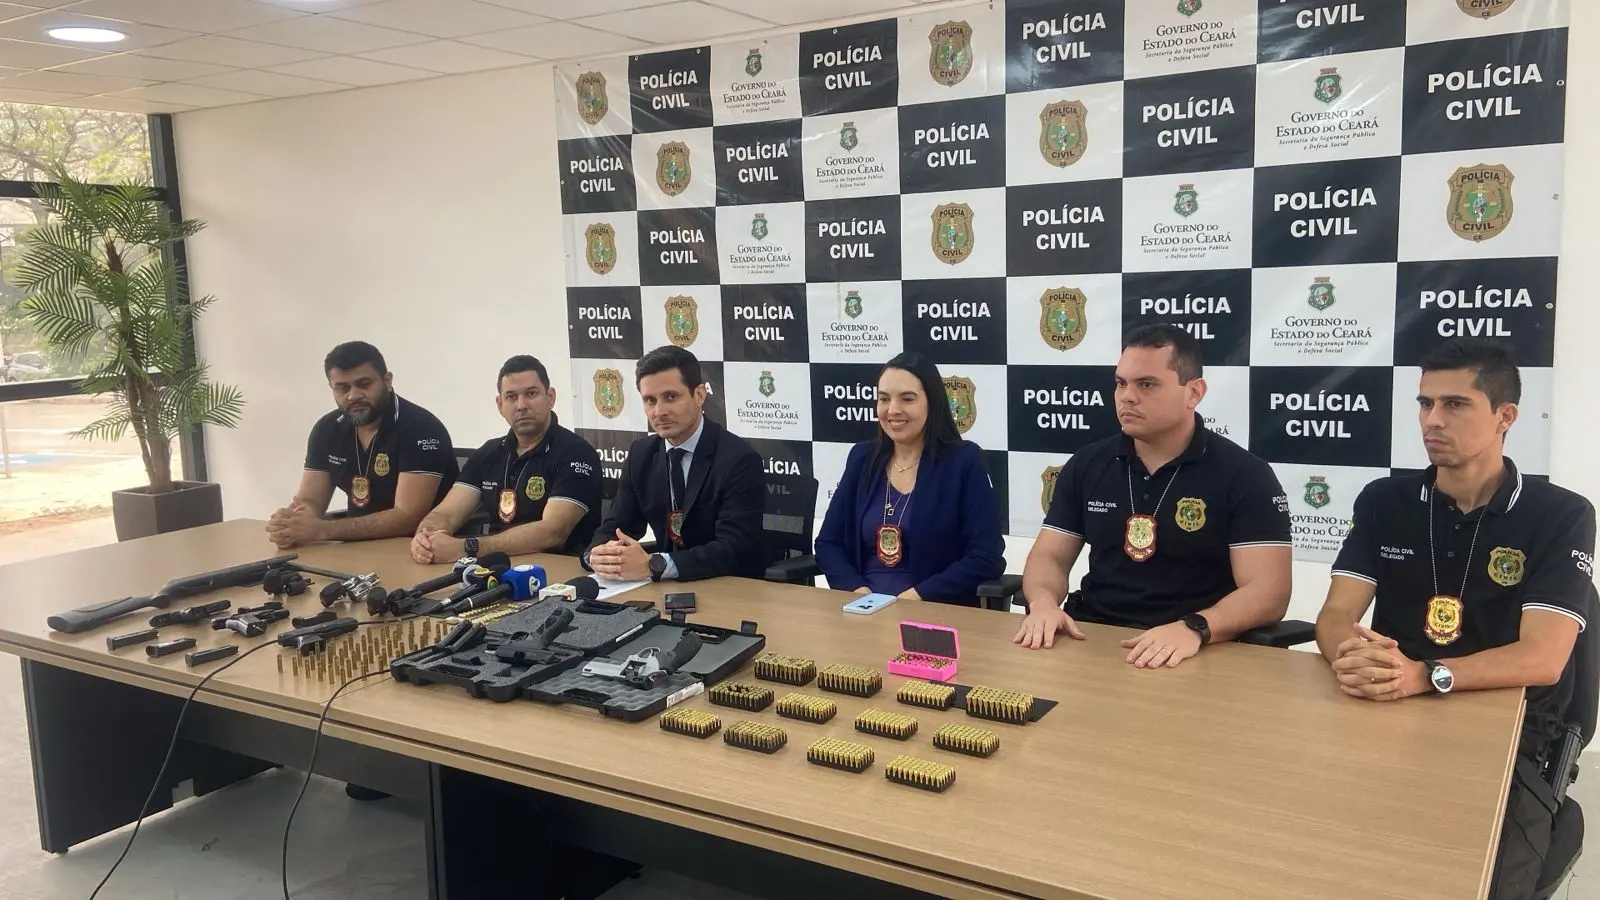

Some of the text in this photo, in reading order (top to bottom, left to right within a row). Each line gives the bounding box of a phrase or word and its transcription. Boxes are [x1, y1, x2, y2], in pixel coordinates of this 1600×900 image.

[1296, 3, 1365, 29] CIVIL
[1023, 13, 1106, 39] POLÍCIA
[1156, 21, 1208, 36] GOVERNO
[1142, 38, 1183, 50] ESTADO
[1199, 28, 1236, 43] CEARÁ
[814, 46, 882, 68] POLÍCIA
[1036, 42, 1090, 63] CIVIL
[641, 70, 697, 90] POLÍCIA
[825, 71, 871, 89] CIVIL
[1428, 64, 1542, 93] POLÍCIA
[653, 93, 689, 109] CIVIL
[1143, 97, 1234, 122] POLÍCIA
[1446, 97, 1520, 120] CIVIL
[1291, 109, 1348, 124] GOVERNO
[915, 123, 989, 145] POLÍCIA
[1158, 126, 1217, 147] CIVIL
[1276, 125, 1320, 137] ESTADO
[727, 142, 788, 162] POLÍCIA
[927, 149, 976, 167] CIVIL
[1051, 150, 1075, 159] CIVIL
[571, 156, 623, 173] POLÍCIA
[739, 167, 778, 182] CIVIL
[1461, 170, 1500, 183] POLÍCIA
[581, 178, 615, 193] CIVIL
[1274, 186, 1377, 211] POLÍCIA
[1023, 205, 1104, 226] POLÍCIA
[819, 218, 886, 237] POLÍCIA
[1153, 223, 1204, 234] GOVERNO
[1291, 217, 1357, 237] CIVIL
[1462, 222, 1495, 231] CIVIL
[650, 227, 704, 244] POLÍCIA
[1037, 233, 1089, 249] CIVIL
[1140, 235, 1180, 246] ESTADO
[1195, 231, 1232, 244] CEARÁ
[661, 251, 697, 264] CIVIL
[830, 243, 874, 258] CIVIL
[942, 249, 963, 257] CIVIL
[1141, 294, 1231, 314] POLÍCIA
[1420, 285, 1532, 308] POLÍCIA
[579, 304, 631, 319] POLÍCIA
[734, 303, 794, 319] POLÍCIA
[918, 300, 990, 318] POLÍCIA
[1285, 316, 1342, 327] GOVERNO
[1438, 318, 1511, 336] CIVIL
[589, 327, 623, 338] CIVIL
[745, 327, 784, 340] CIVIL
[931, 326, 977, 340] CIVIL
[1051, 334, 1075, 343] CIVIL
[1271, 328, 1314, 339] ESTADO
[1332, 326, 1372, 339] CEARÁ
[824, 382, 878, 400] POLÍCI
[1024, 387, 1104, 406] POLÍCIA
[1271, 390, 1369, 411] POLÍCIA
[835, 406, 879, 422] CIVIL
[1038, 413, 1089, 429] CIVIL
[1286, 420, 1351, 437] CIVIL
[596, 446, 629, 463] OLÍCI
[1291, 515, 1337, 524] OVERNO
